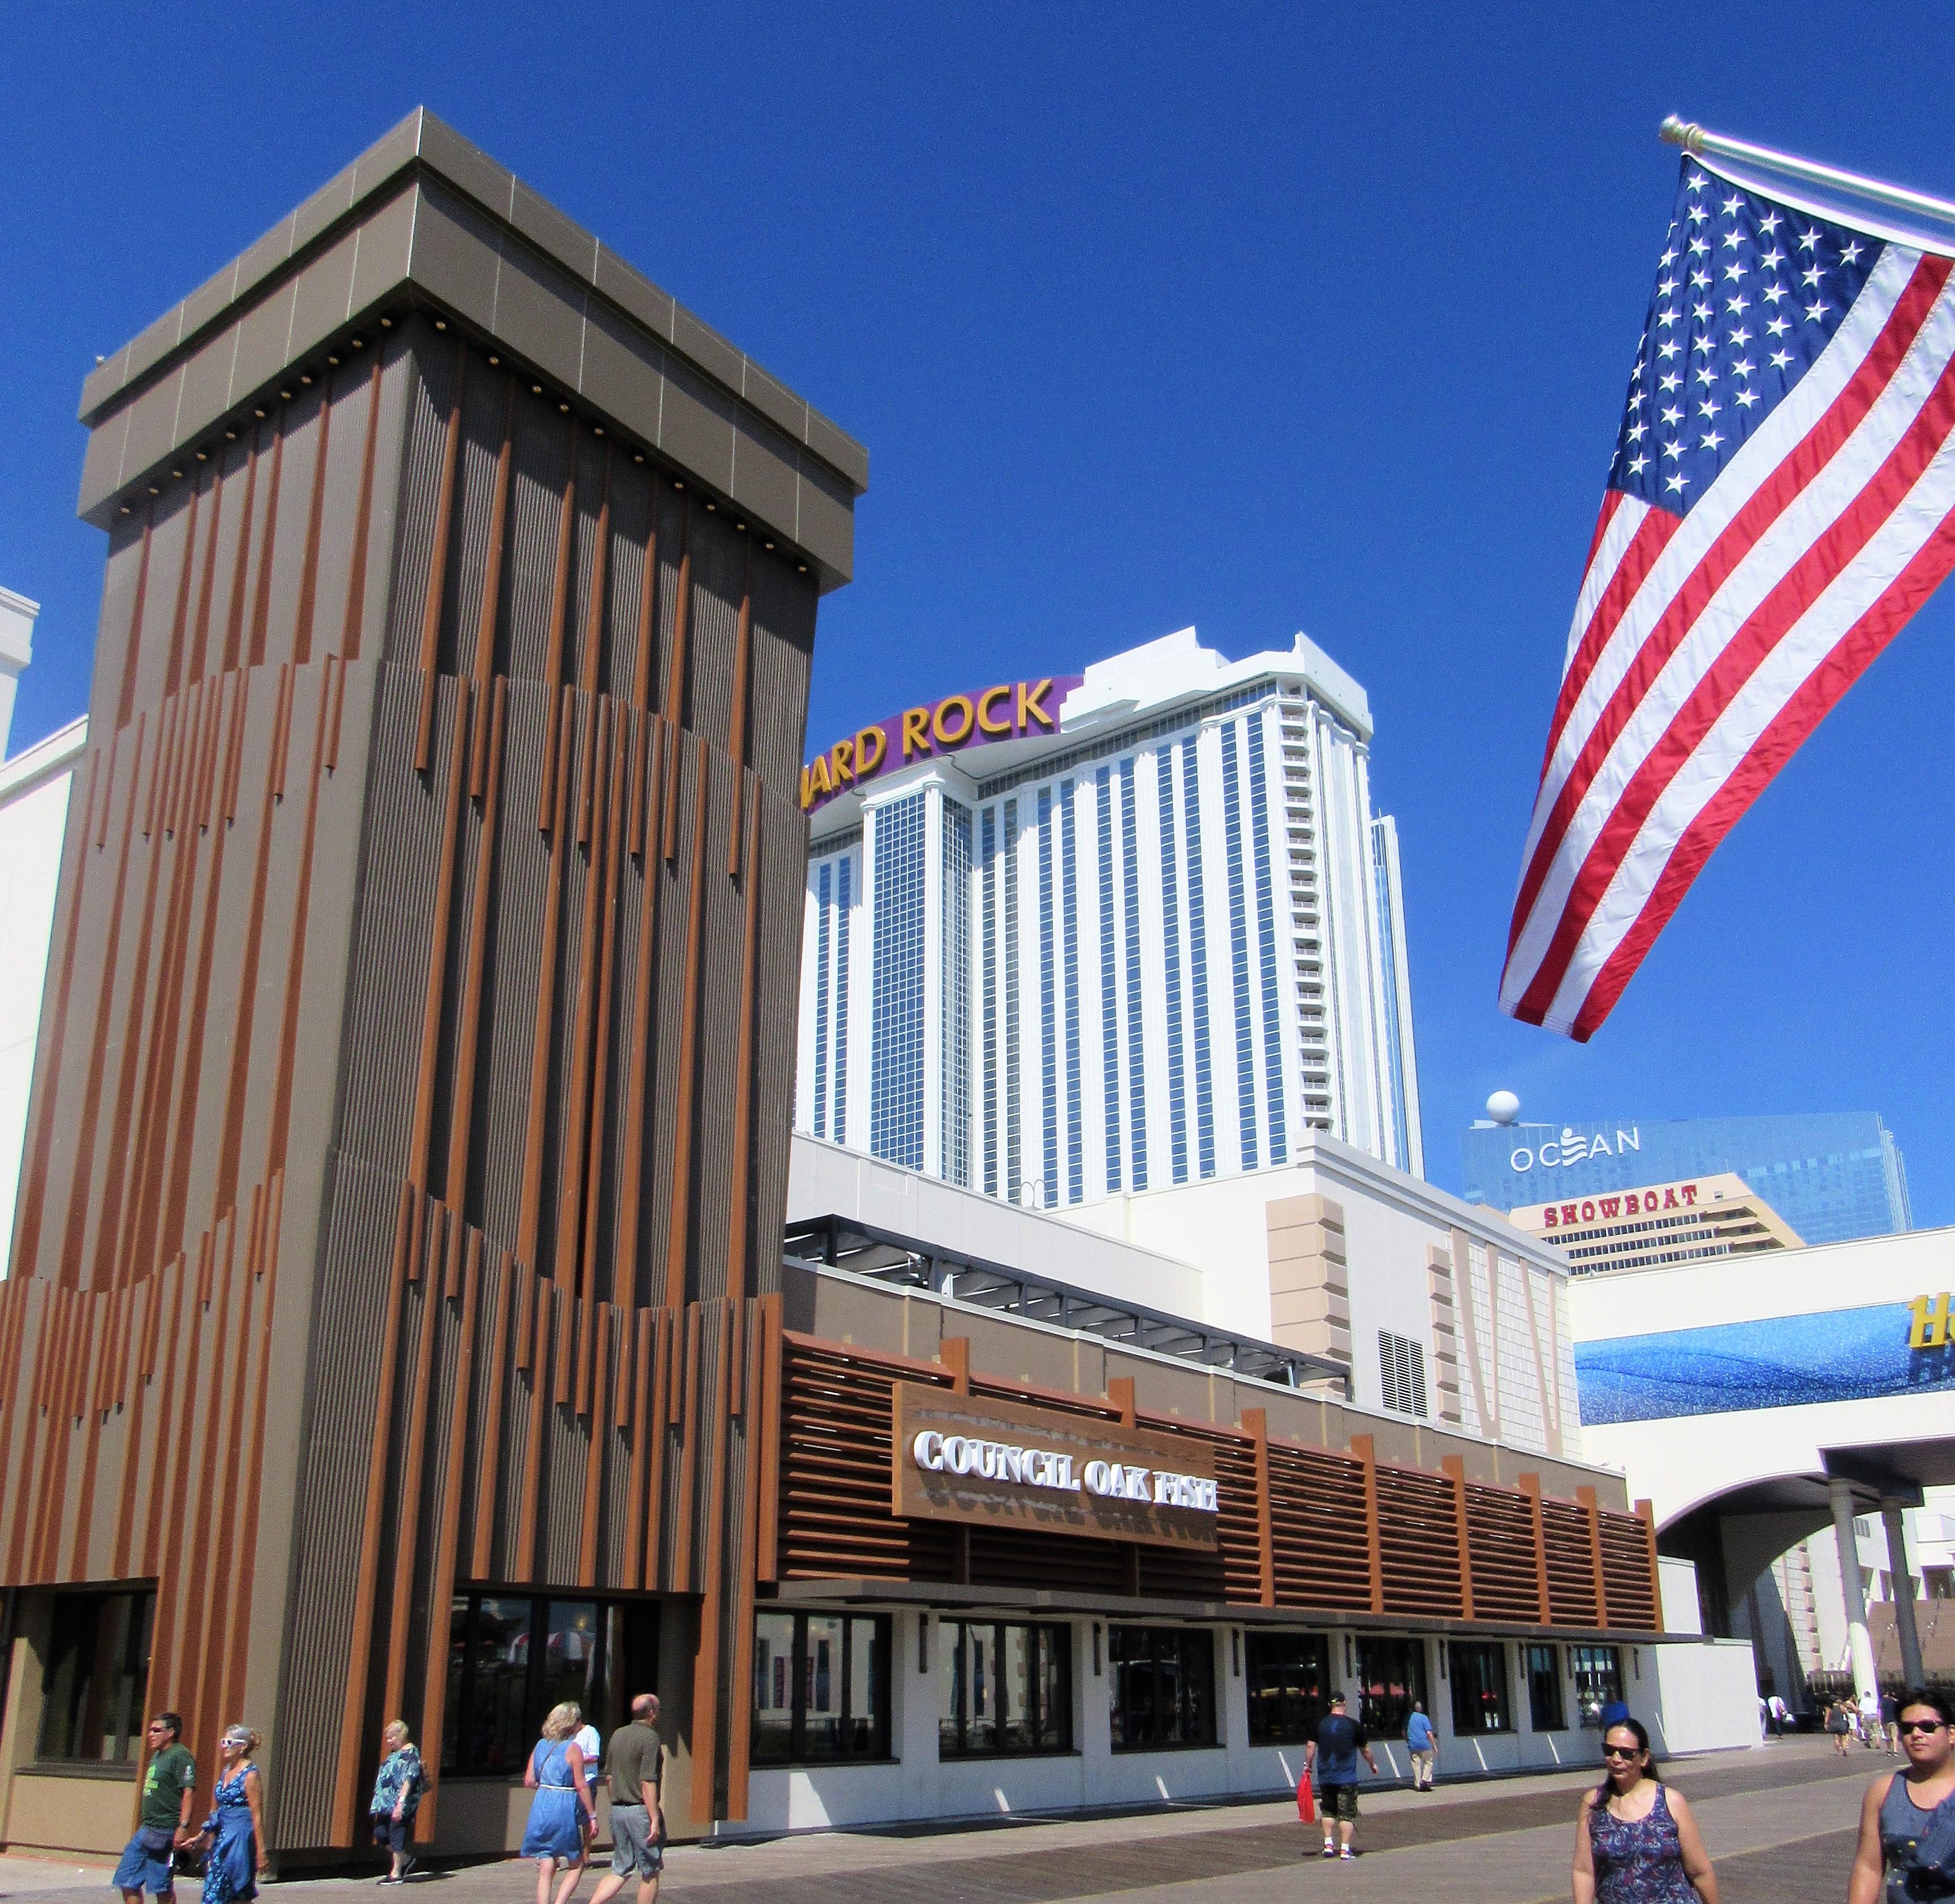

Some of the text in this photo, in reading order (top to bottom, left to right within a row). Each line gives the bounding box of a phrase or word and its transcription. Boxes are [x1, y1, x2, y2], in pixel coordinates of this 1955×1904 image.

[903, 679, 1053, 755] ROCK
[1510, 1127, 1640, 1172] OCEAN
[1543, 1184, 1698, 1228] SHOWBOAT
[1907, 1292, 1955, 1348] H
[913, 1430, 1219, 1512] COUNCIL OAK FISH
